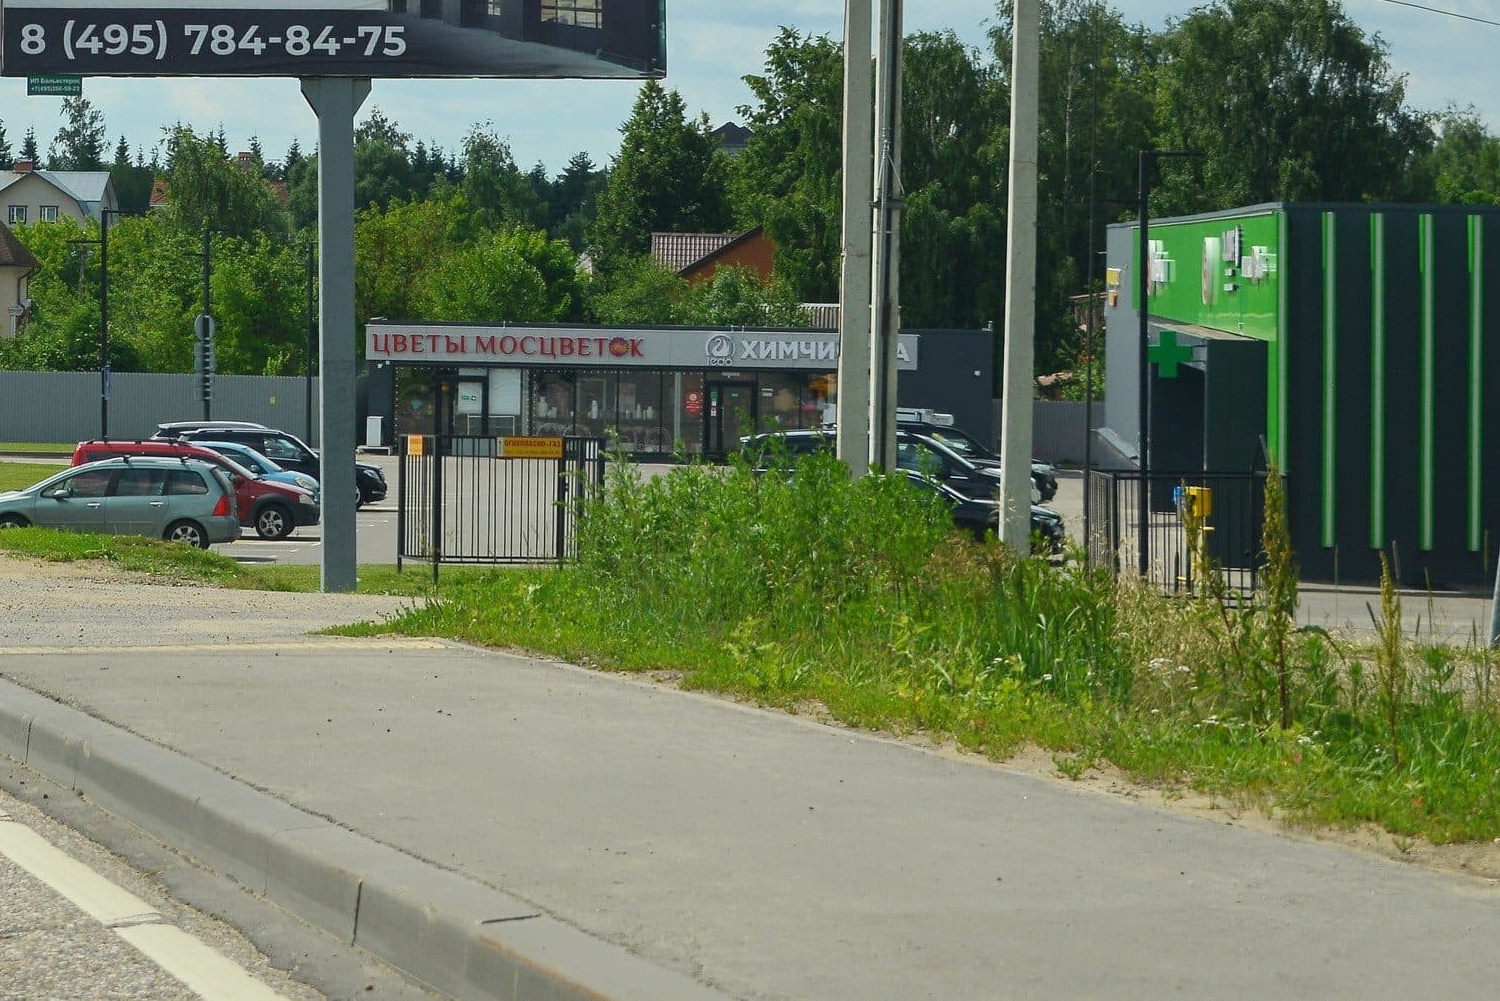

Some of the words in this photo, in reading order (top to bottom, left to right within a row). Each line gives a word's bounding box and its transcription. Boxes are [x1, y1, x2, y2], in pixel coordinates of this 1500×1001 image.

[20, 23, 46, 55] 8
[63, 20, 168, 60] (495)
[184, 24, 407, 57] 784-84-75
[372, 333, 466, 356] ЦВЕТЫ
[474, 335, 646, 360] МОСЦВЕТОК
[740, 340, 910, 362] ХИМЧИА
